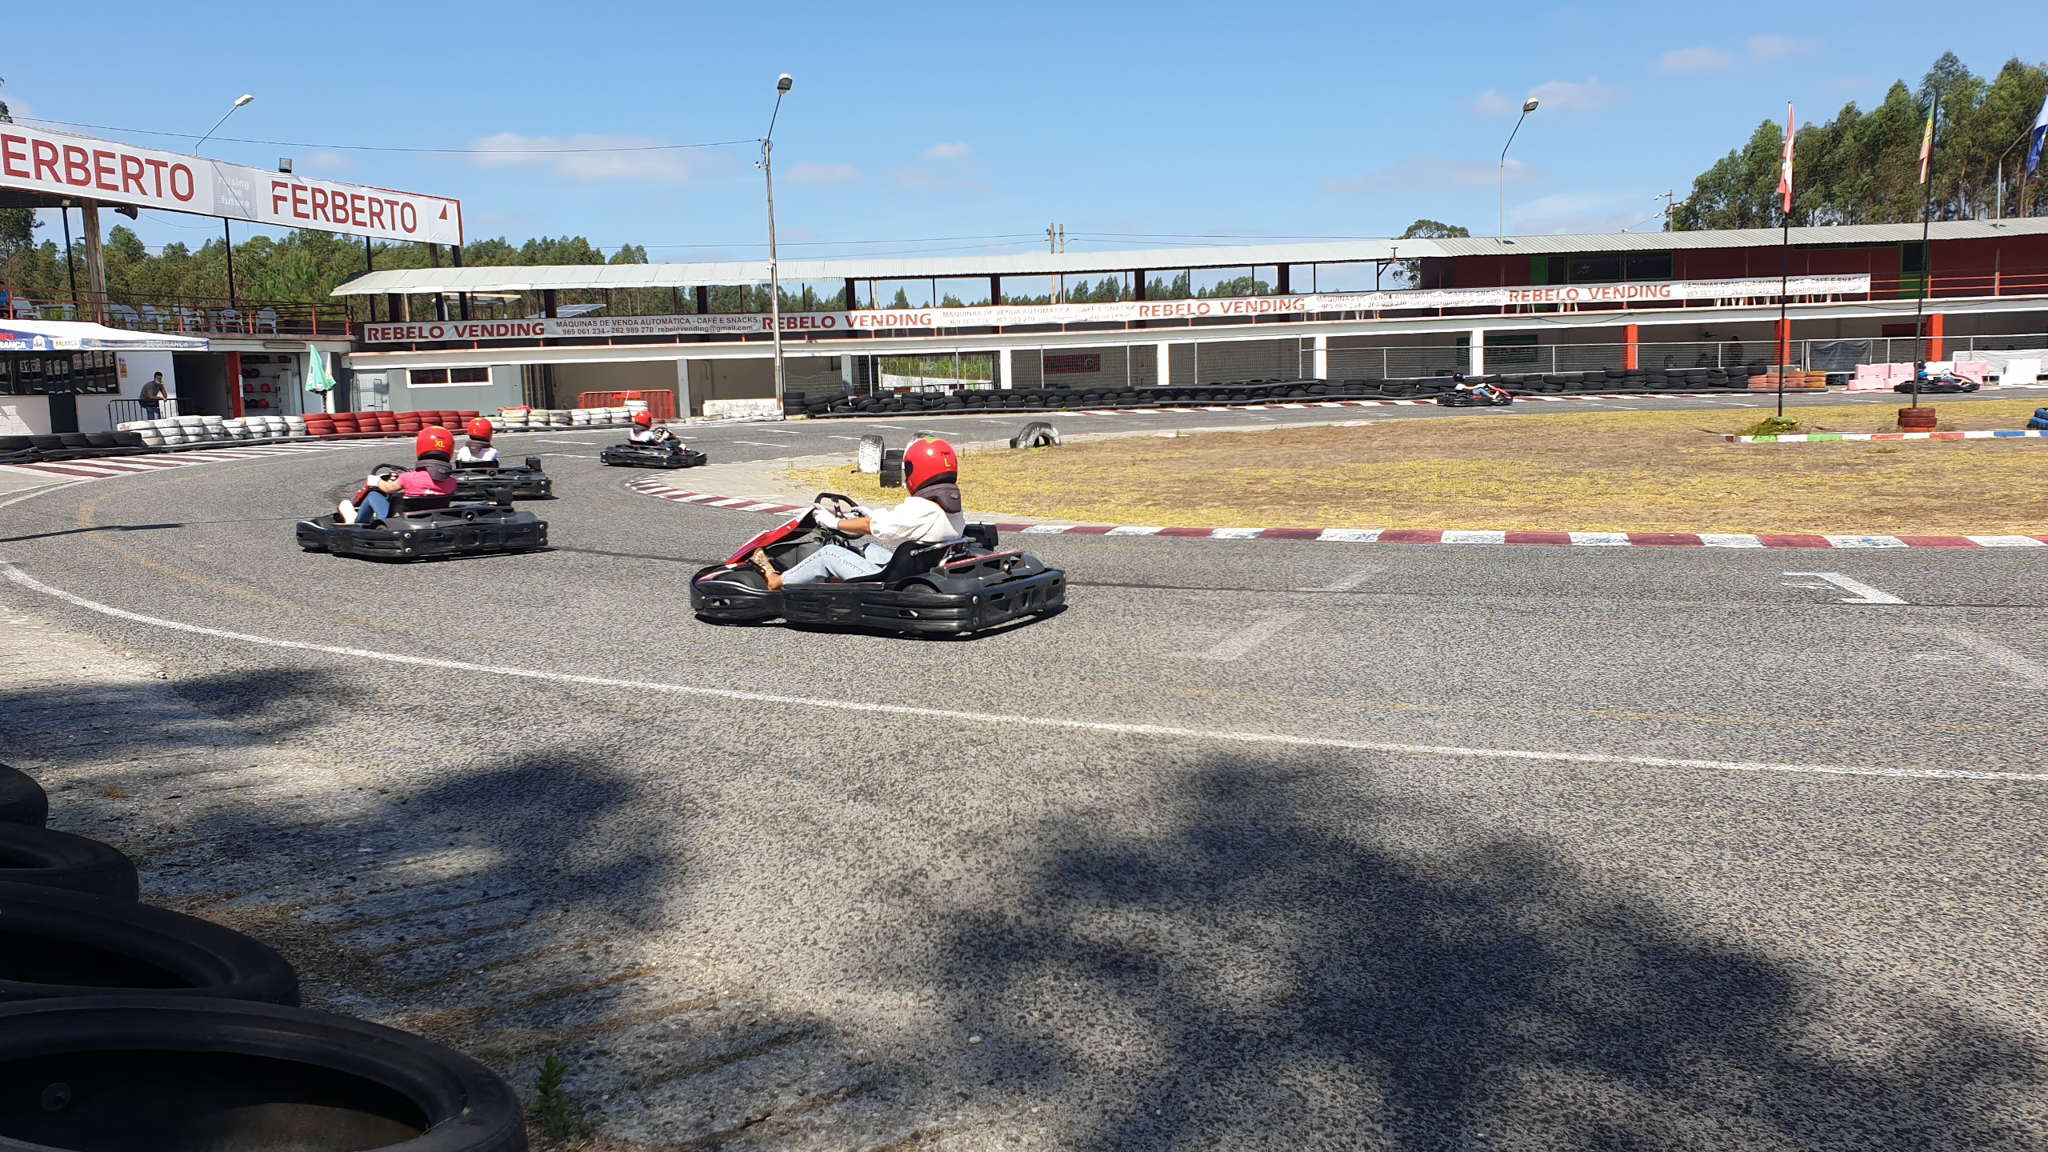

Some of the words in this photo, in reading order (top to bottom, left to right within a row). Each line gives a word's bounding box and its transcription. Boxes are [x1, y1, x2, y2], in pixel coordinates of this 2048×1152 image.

[1, 134, 194, 202] ERBERTO
[221, 195, 249, 208] future
[272, 180, 417, 233] FERBERTO
[1509, 287, 1579, 302] REBELO
[1588, 284, 1671, 299] VENDING
[1139, 303, 1211, 317] REBELO
[1220, 298, 1305, 314] VENDING
[640, 317, 691, 326] AUTOMÁTICA
[697, 316, 717, 324] CAFÉ
[727, 316, 758, 324] SNACKS
[762, 315, 836, 330] REBELO
[845, 313, 932, 328] VENDING
[367, 324, 445, 341] REBELO
[453, 322, 545, 338] VENDING
[435, 440, 445, 448] XL
[944, 457, 951, 467] L
